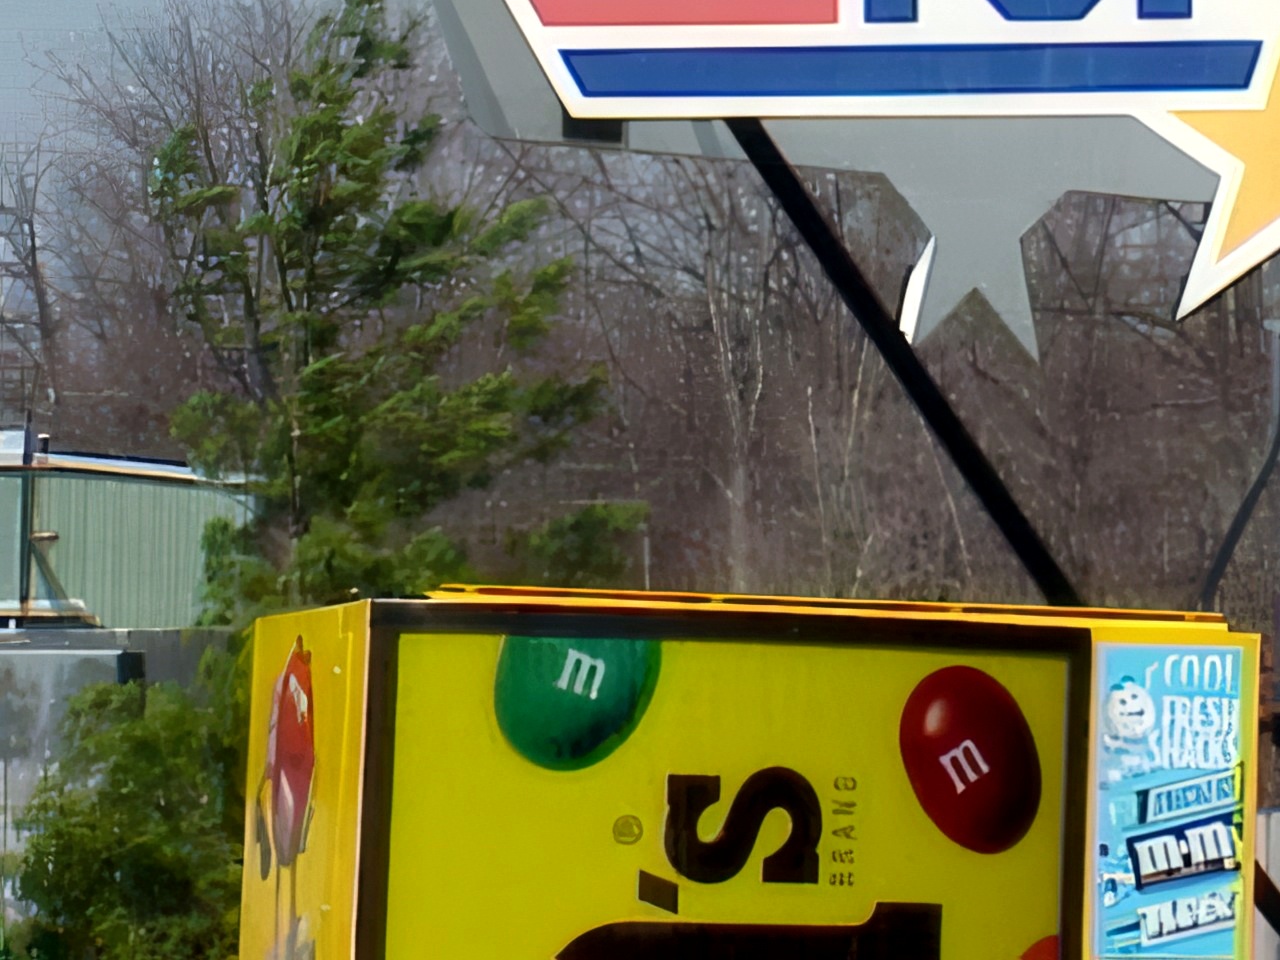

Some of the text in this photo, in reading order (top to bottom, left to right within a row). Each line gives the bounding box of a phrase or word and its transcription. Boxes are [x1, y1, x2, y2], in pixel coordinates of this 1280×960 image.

[553, 648, 606, 700] m
[1163, 653, 1234, 695] COOL
[938, 739, 991, 795] m
